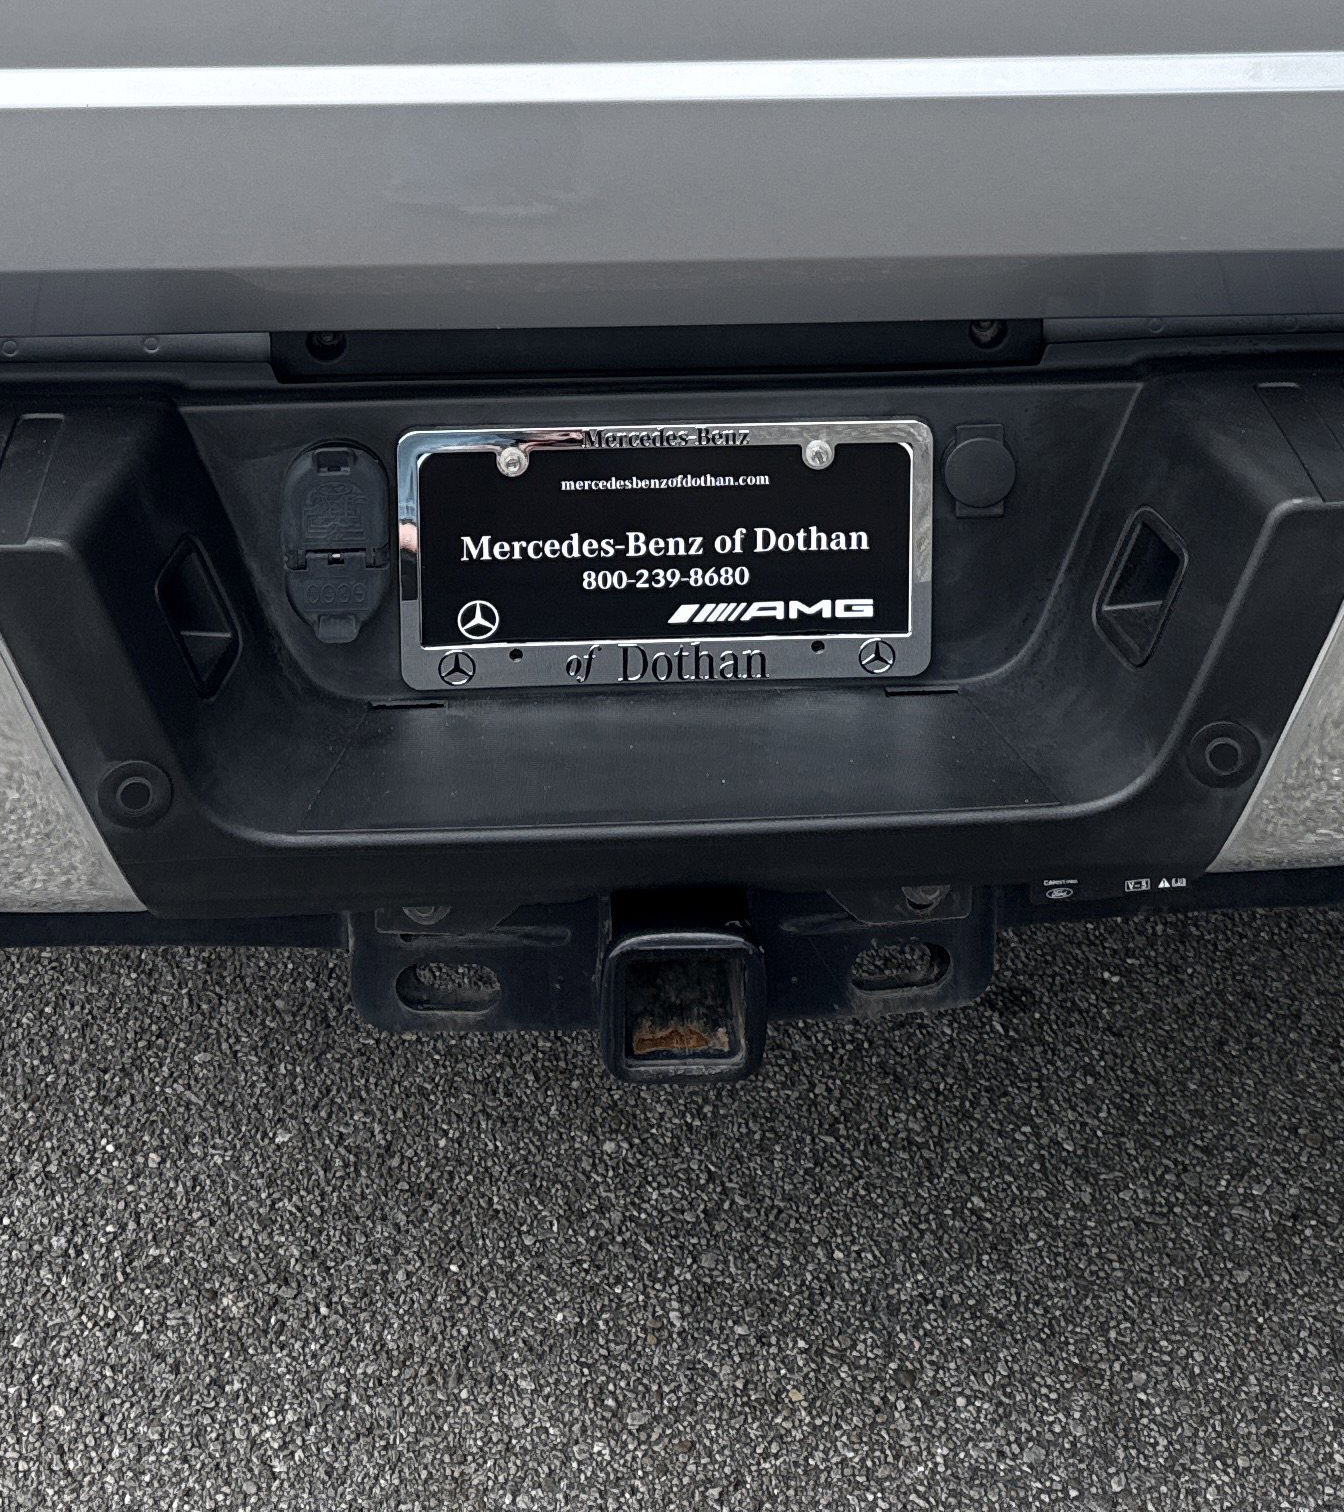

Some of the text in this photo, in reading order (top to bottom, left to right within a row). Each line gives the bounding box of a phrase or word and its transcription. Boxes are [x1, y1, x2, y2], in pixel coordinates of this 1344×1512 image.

[582, 426, 750, 448] Mercedes-Benz
[560, 473, 771, 492] mercedesbenzofdothan.com
[460, 526, 870, 562] Mercedes-Benz of Dothan
[582, 566, 750, 590] 800-239-8680
[741, 599, 874, 621] AMG
[565, 643, 770, 683] of Dothan
